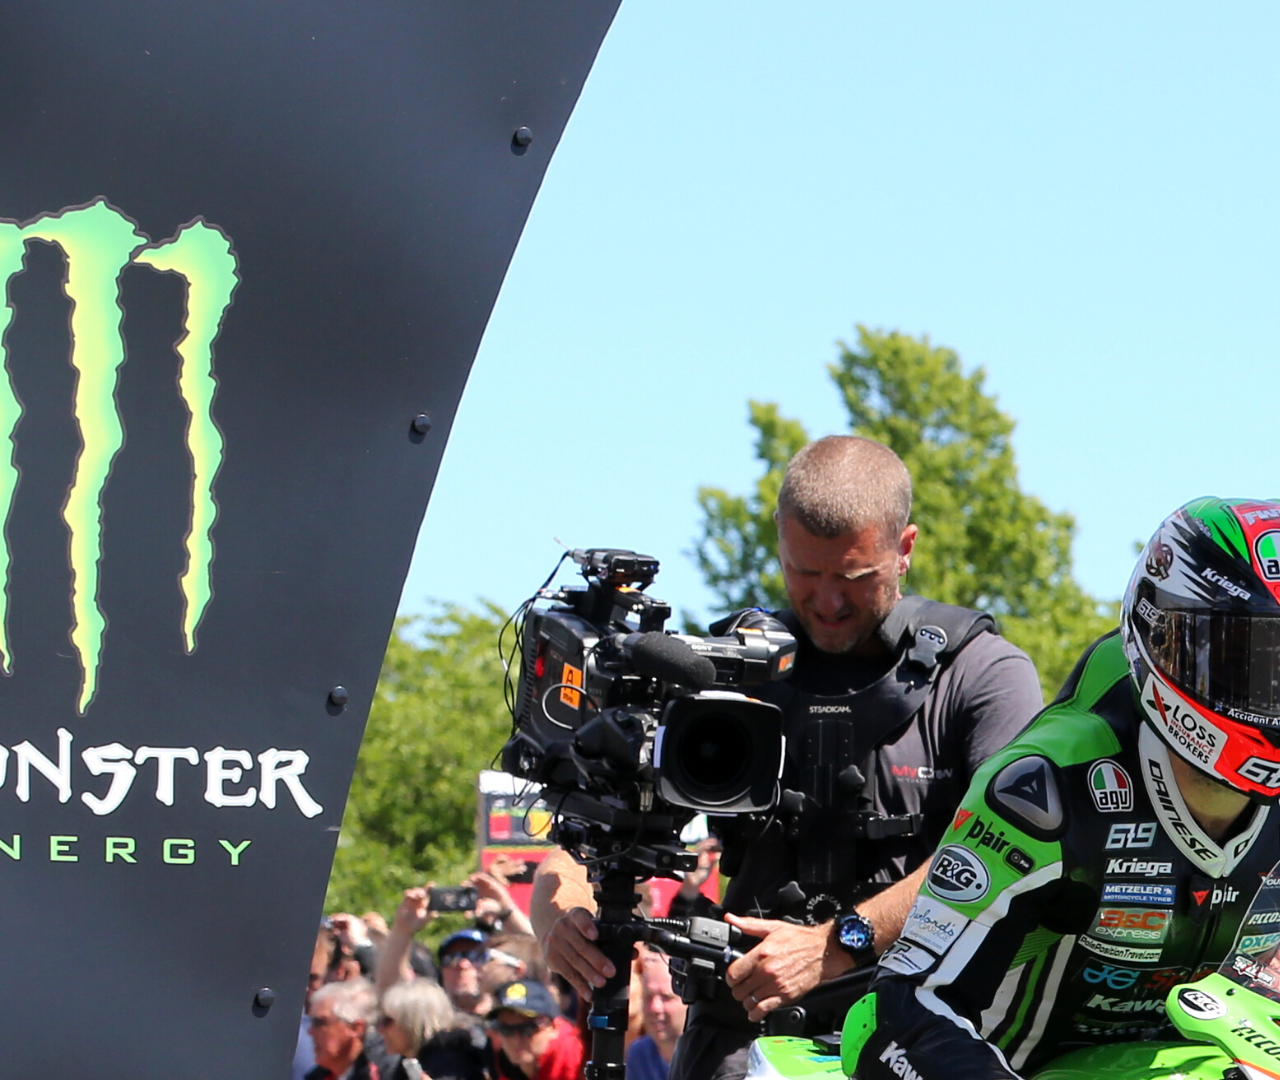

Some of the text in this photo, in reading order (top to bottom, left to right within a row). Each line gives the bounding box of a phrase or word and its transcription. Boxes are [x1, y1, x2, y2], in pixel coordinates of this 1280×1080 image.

[1200, 567, 1251, 601] Kriega
[1172, 704, 1217, 748] LOSS
[1227, 709, 1269, 725] Accident
[1167, 725, 1211, 764] BROKERS
[1170, 719, 1215, 756] INSURANCE
[1098, 789, 1129, 810] agv
[1148, 758, 1218, 861] DAINESE
[934, 855, 978, 889] R&G
[1106, 858, 1172, 877] Kriega
[1105, 886, 1162, 895] METZELER
[1098, 909, 1166, 930] B&C
[919, 923, 950, 942] GARAGE
[1095, 927, 1161, 940] express
[1081, 936, 1161, 960] PolePositionTravel.com
